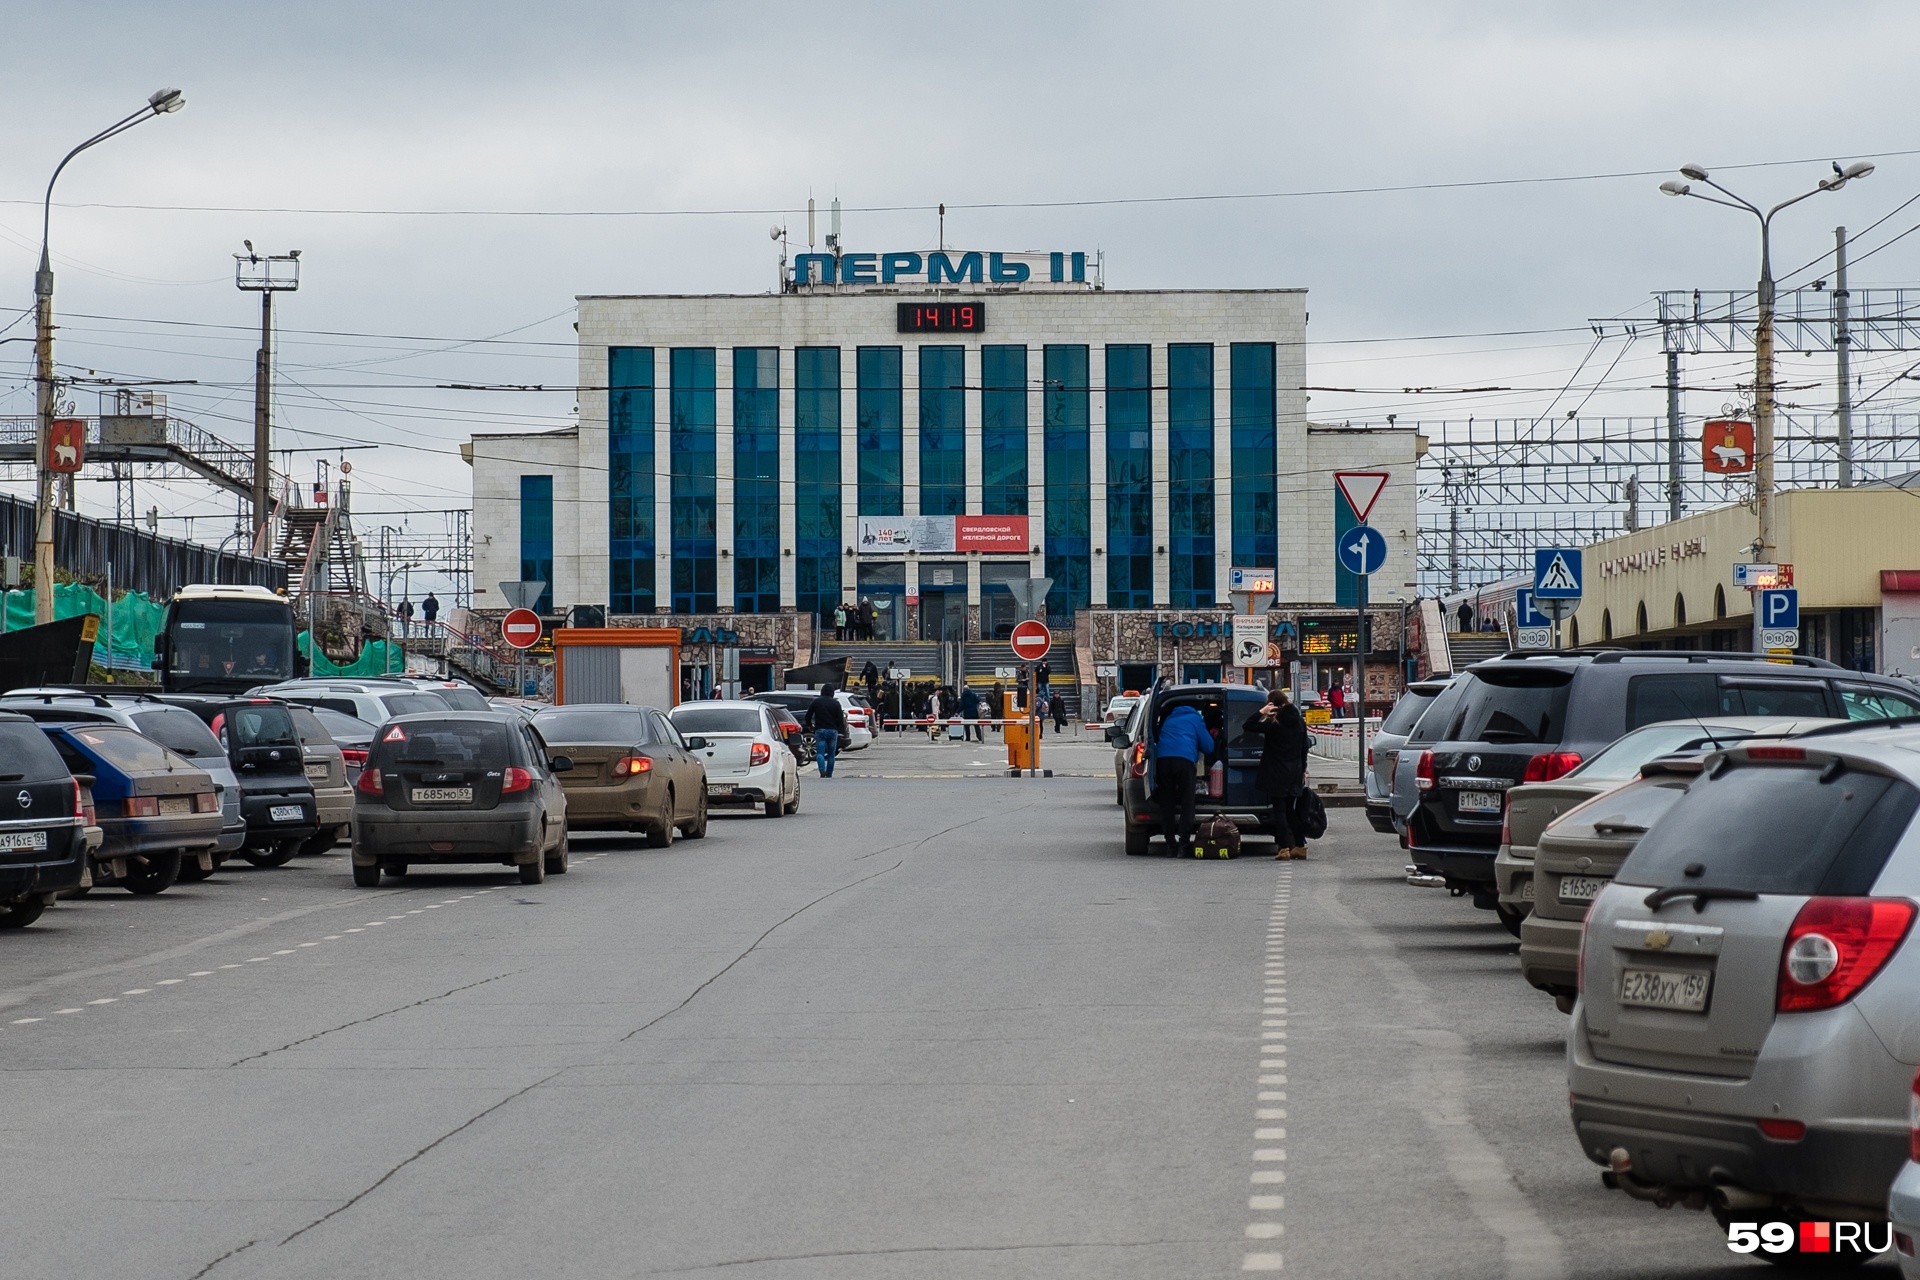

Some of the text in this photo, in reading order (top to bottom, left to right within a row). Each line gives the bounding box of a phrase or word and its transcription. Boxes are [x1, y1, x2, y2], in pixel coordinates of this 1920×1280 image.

[794, 252, 1085, 284] ПЕРМЬ II
[916, 307, 973, 328] 14 19
[1784, 635, 1794, 643] 20
[416, 788, 469, 799] Т685МО 59
[0, 834, 32, 847] А916ХЕ
[1561, 879, 1598, 896] Е165ОР
[1623, 974, 1705, 1003] Е238ХХ 159
